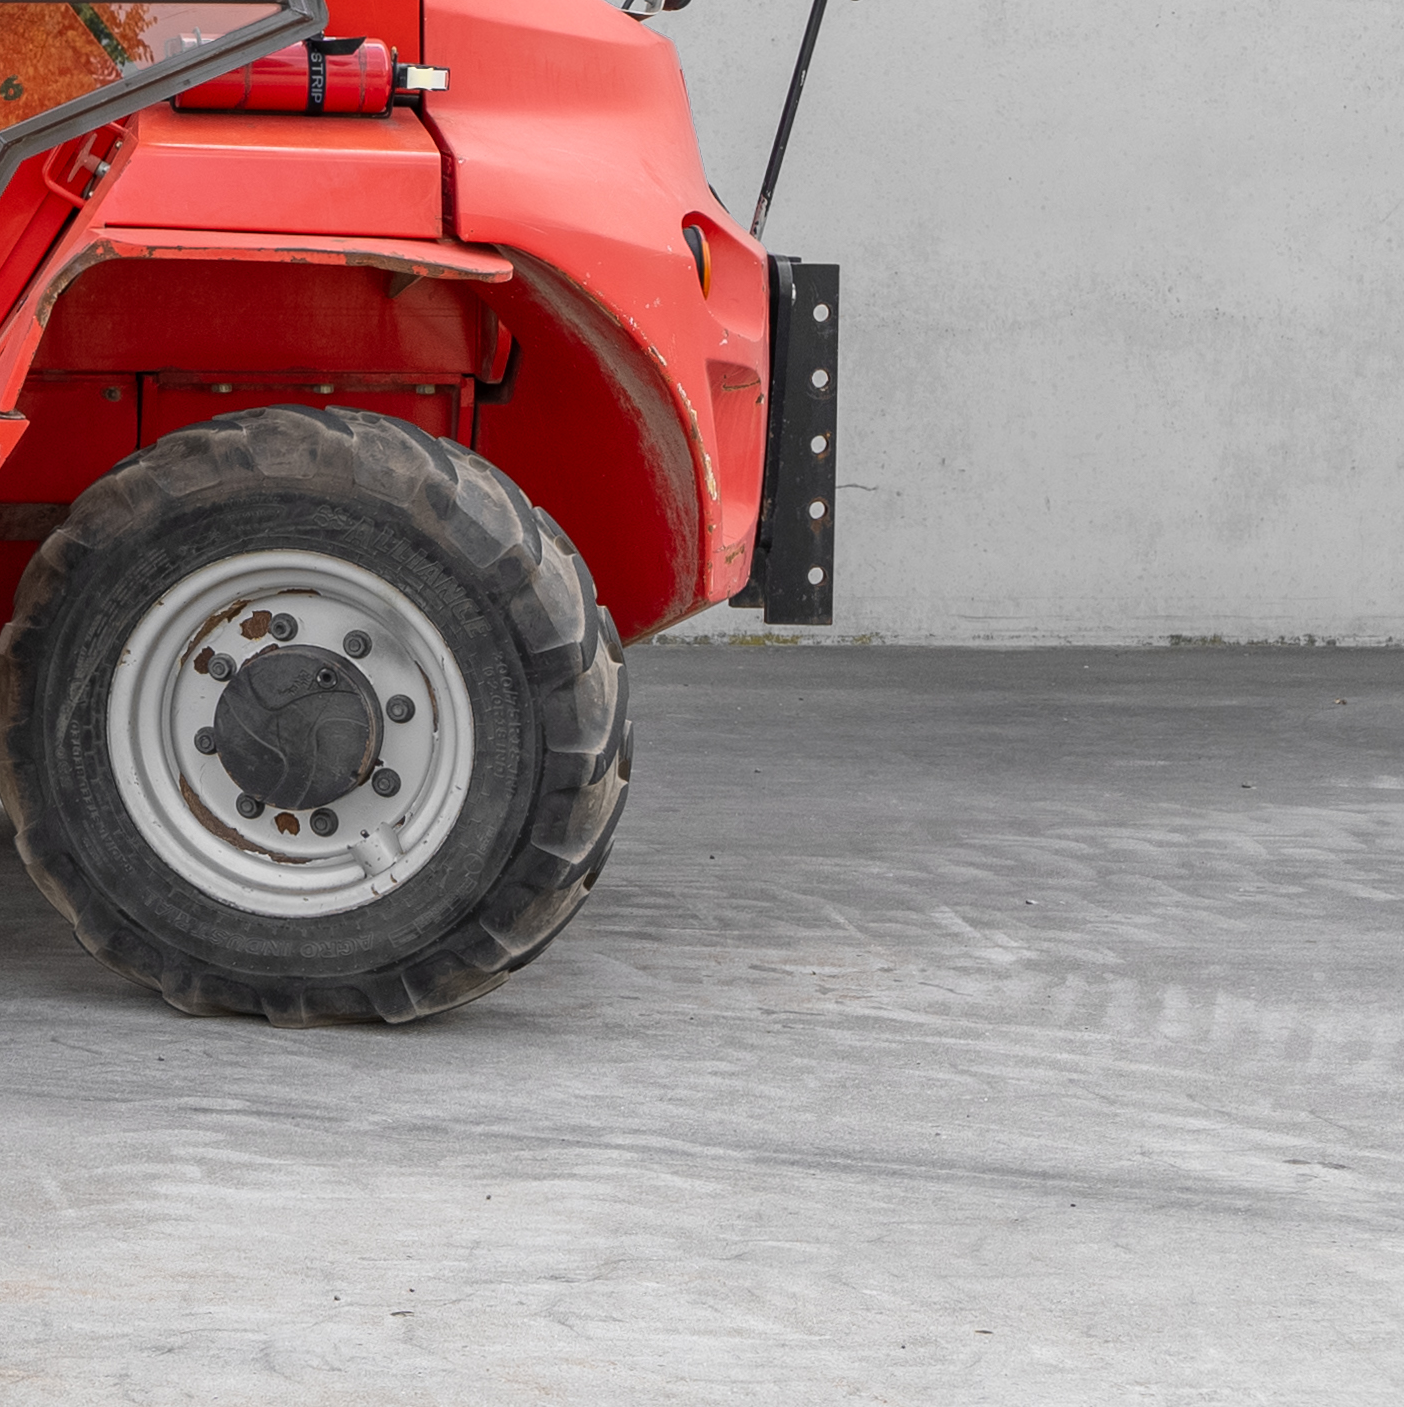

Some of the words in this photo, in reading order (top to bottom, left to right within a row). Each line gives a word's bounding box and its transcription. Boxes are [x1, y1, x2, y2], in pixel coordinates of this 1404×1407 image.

[343, 511, 495, 643] ALLIANCE
[136, 883, 292, 959] INDUSTRIAL
[299, 925, 378, 963] AGRO
